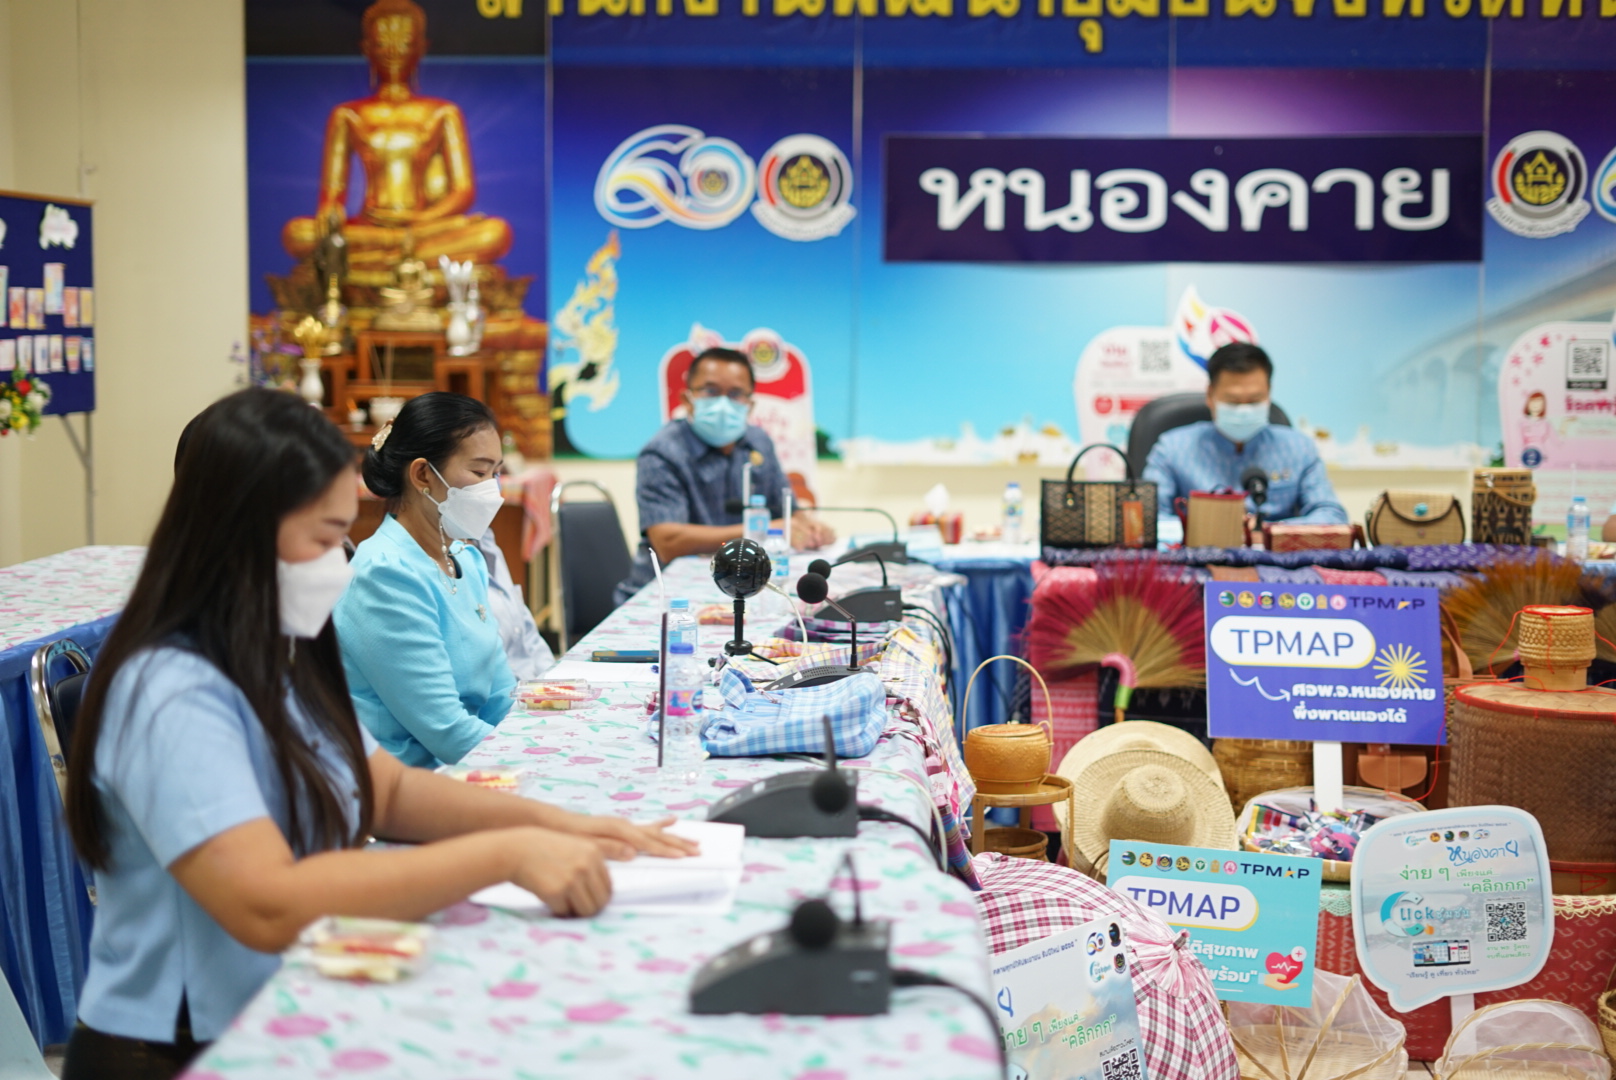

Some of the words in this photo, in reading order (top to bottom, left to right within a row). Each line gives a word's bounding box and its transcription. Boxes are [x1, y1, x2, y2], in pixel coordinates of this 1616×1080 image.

[919, 166, 1450, 232] หนองคาย
[1229, 628, 1354, 657] TPMAP
[1240, 863, 1310, 879] TPMAP
[1399, 864, 1432, 880] ง่าย
[1127, 887, 1240, 920] TPMAP
